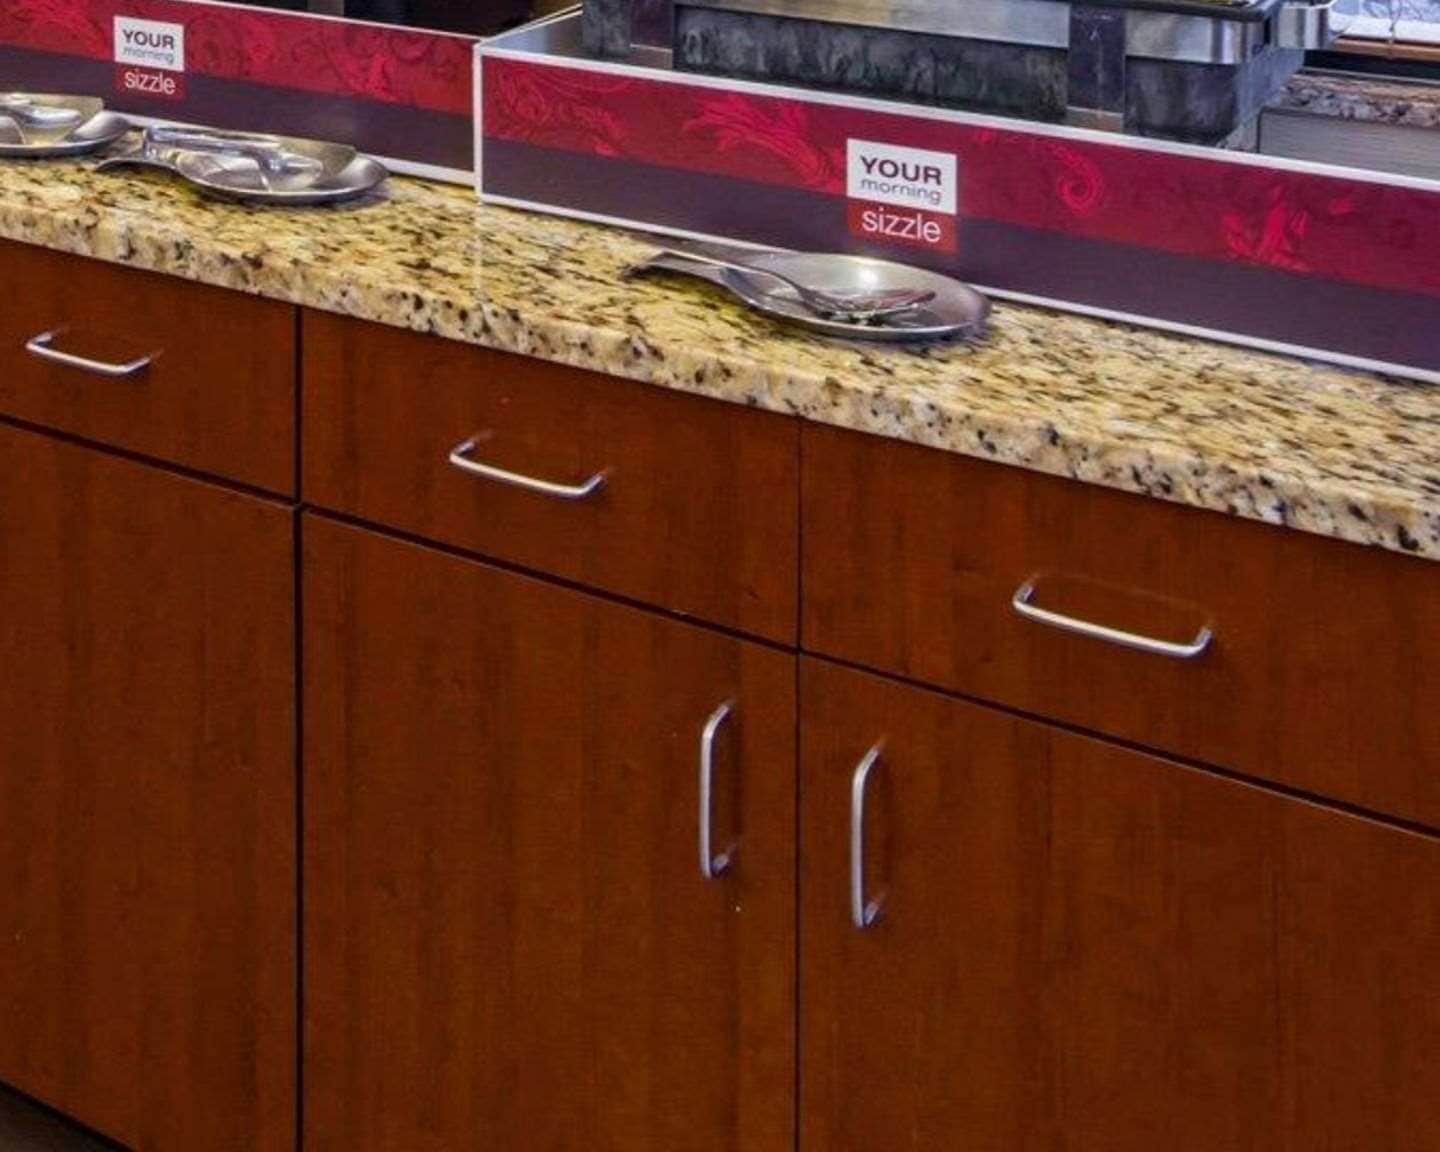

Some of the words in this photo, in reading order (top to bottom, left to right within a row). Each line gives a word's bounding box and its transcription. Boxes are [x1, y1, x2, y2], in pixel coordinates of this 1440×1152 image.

[122, 29, 175, 50] YOUR
[123, 47, 175, 65] morning
[124, 68, 176, 95] sizzle
[860, 155, 942, 185] YOUR
[861, 177, 942, 205] morning
[862, 208, 941, 243] sizzle
